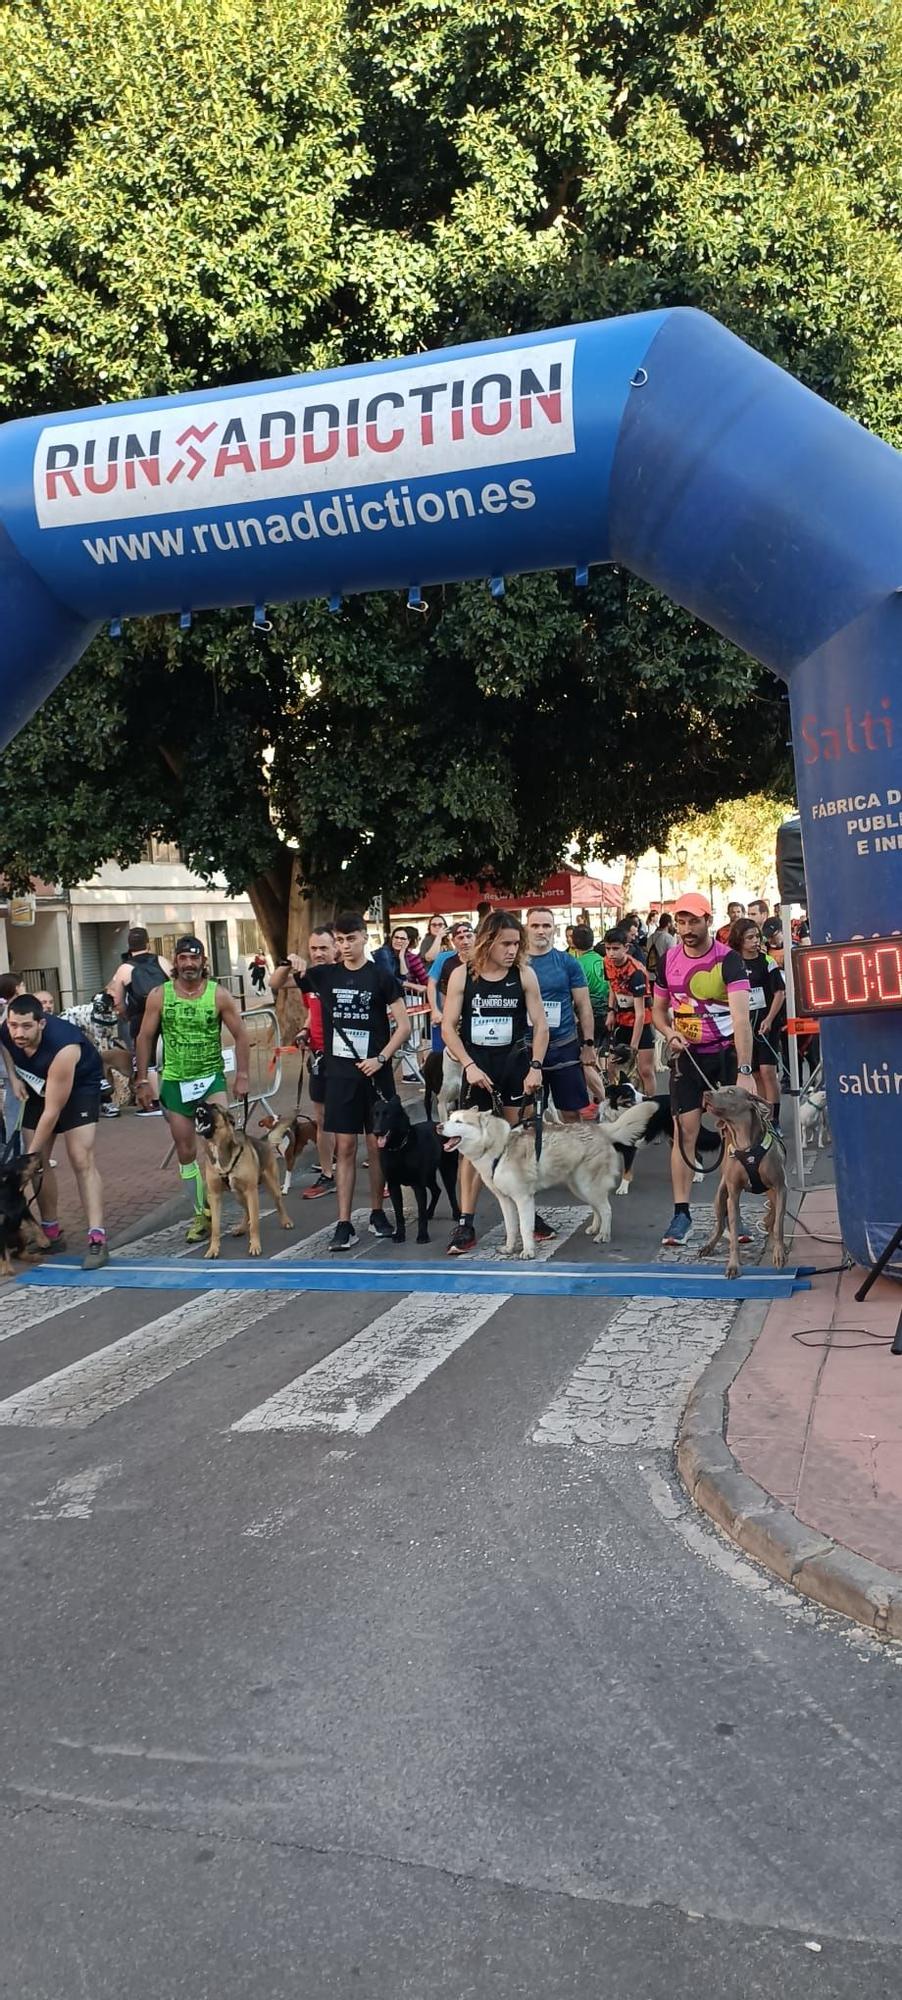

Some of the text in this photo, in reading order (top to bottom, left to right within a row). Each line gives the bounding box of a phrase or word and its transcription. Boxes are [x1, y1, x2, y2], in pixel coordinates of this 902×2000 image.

[46, 363, 562, 500] RUN ADDICTION
[82, 478, 536, 565] www.runaddiction.es
[812, 793, 882, 820] FÁBRICA
[857, 840, 870, 855] E
[488, 1028, 495, 1036] 6
[193, 1082, 205, 1091] 24
